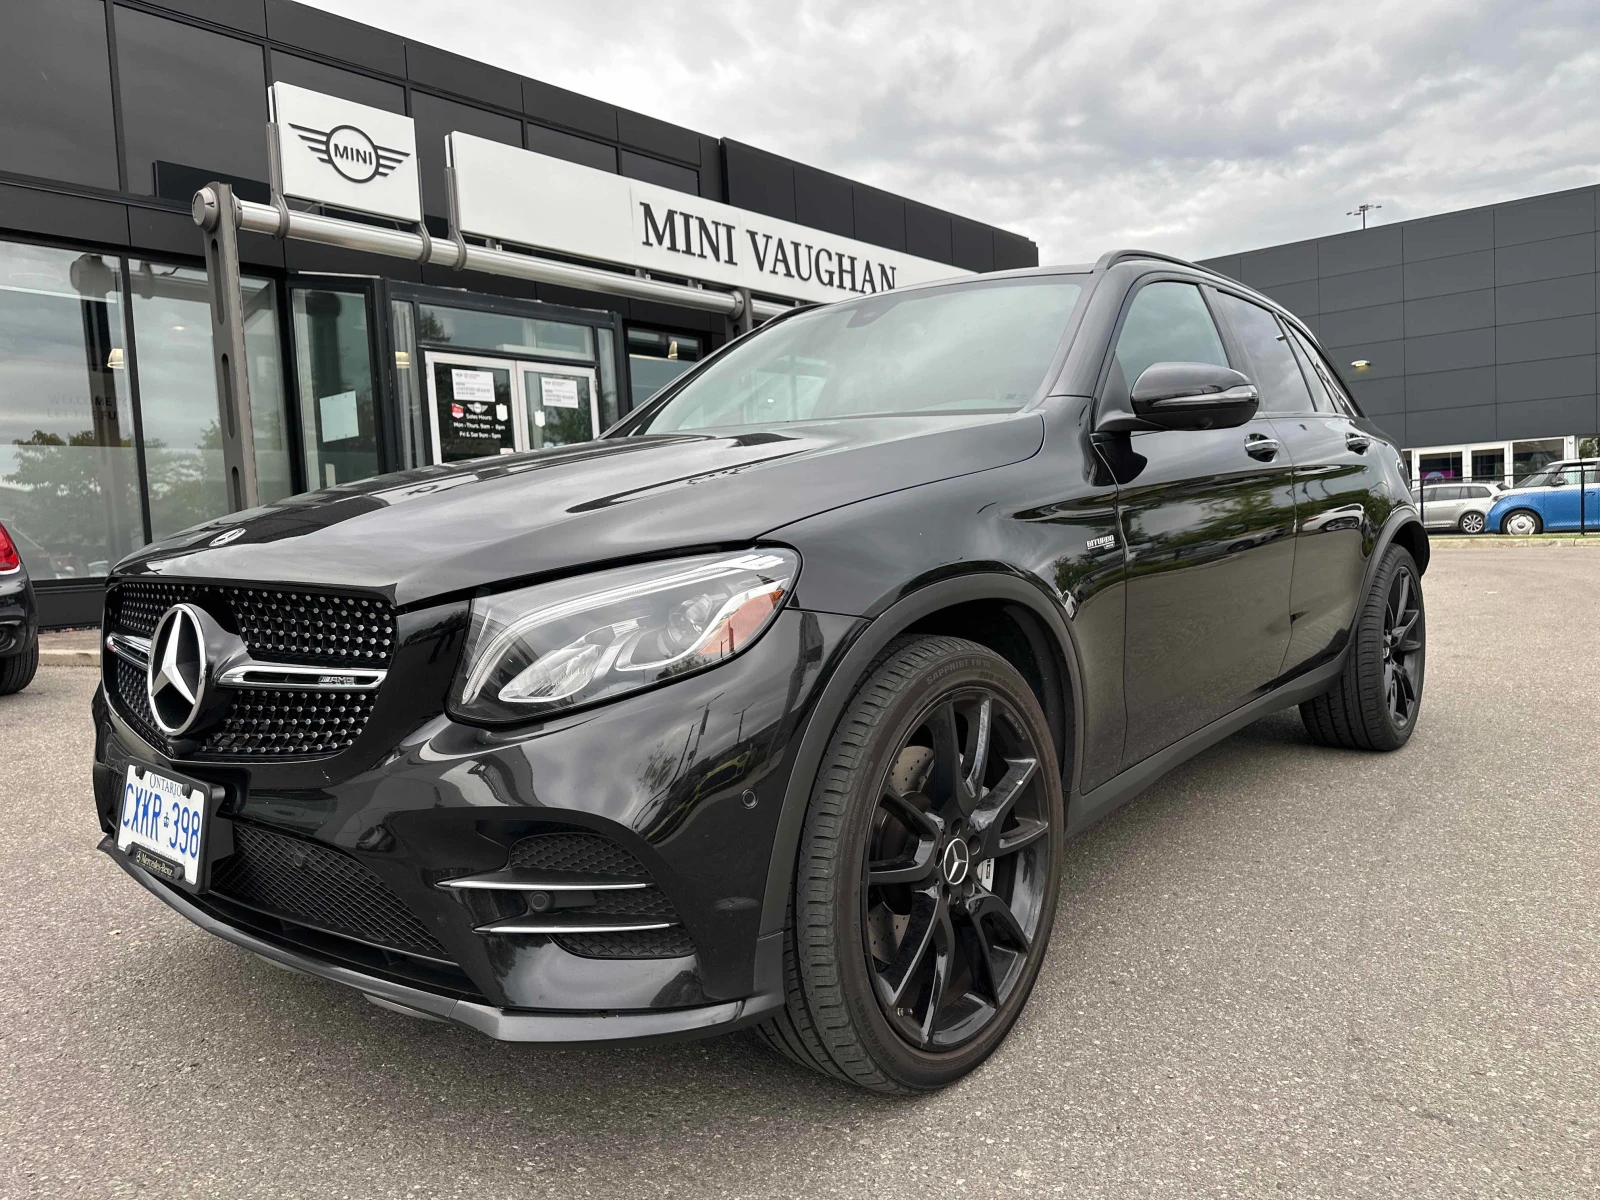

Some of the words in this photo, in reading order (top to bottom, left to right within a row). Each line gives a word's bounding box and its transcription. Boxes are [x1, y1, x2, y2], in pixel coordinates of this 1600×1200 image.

[333, 143, 373, 166] MINI
[639, 202, 738, 266] MINI
[746, 229, 897, 295] VAUGHAN
[926, 659, 969, 684] SAPPHIRE
[149, 773, 182, 797] ONTARIO
[122, 783, 162, 842] CXKR
[169, 802, 201, 858] 398
